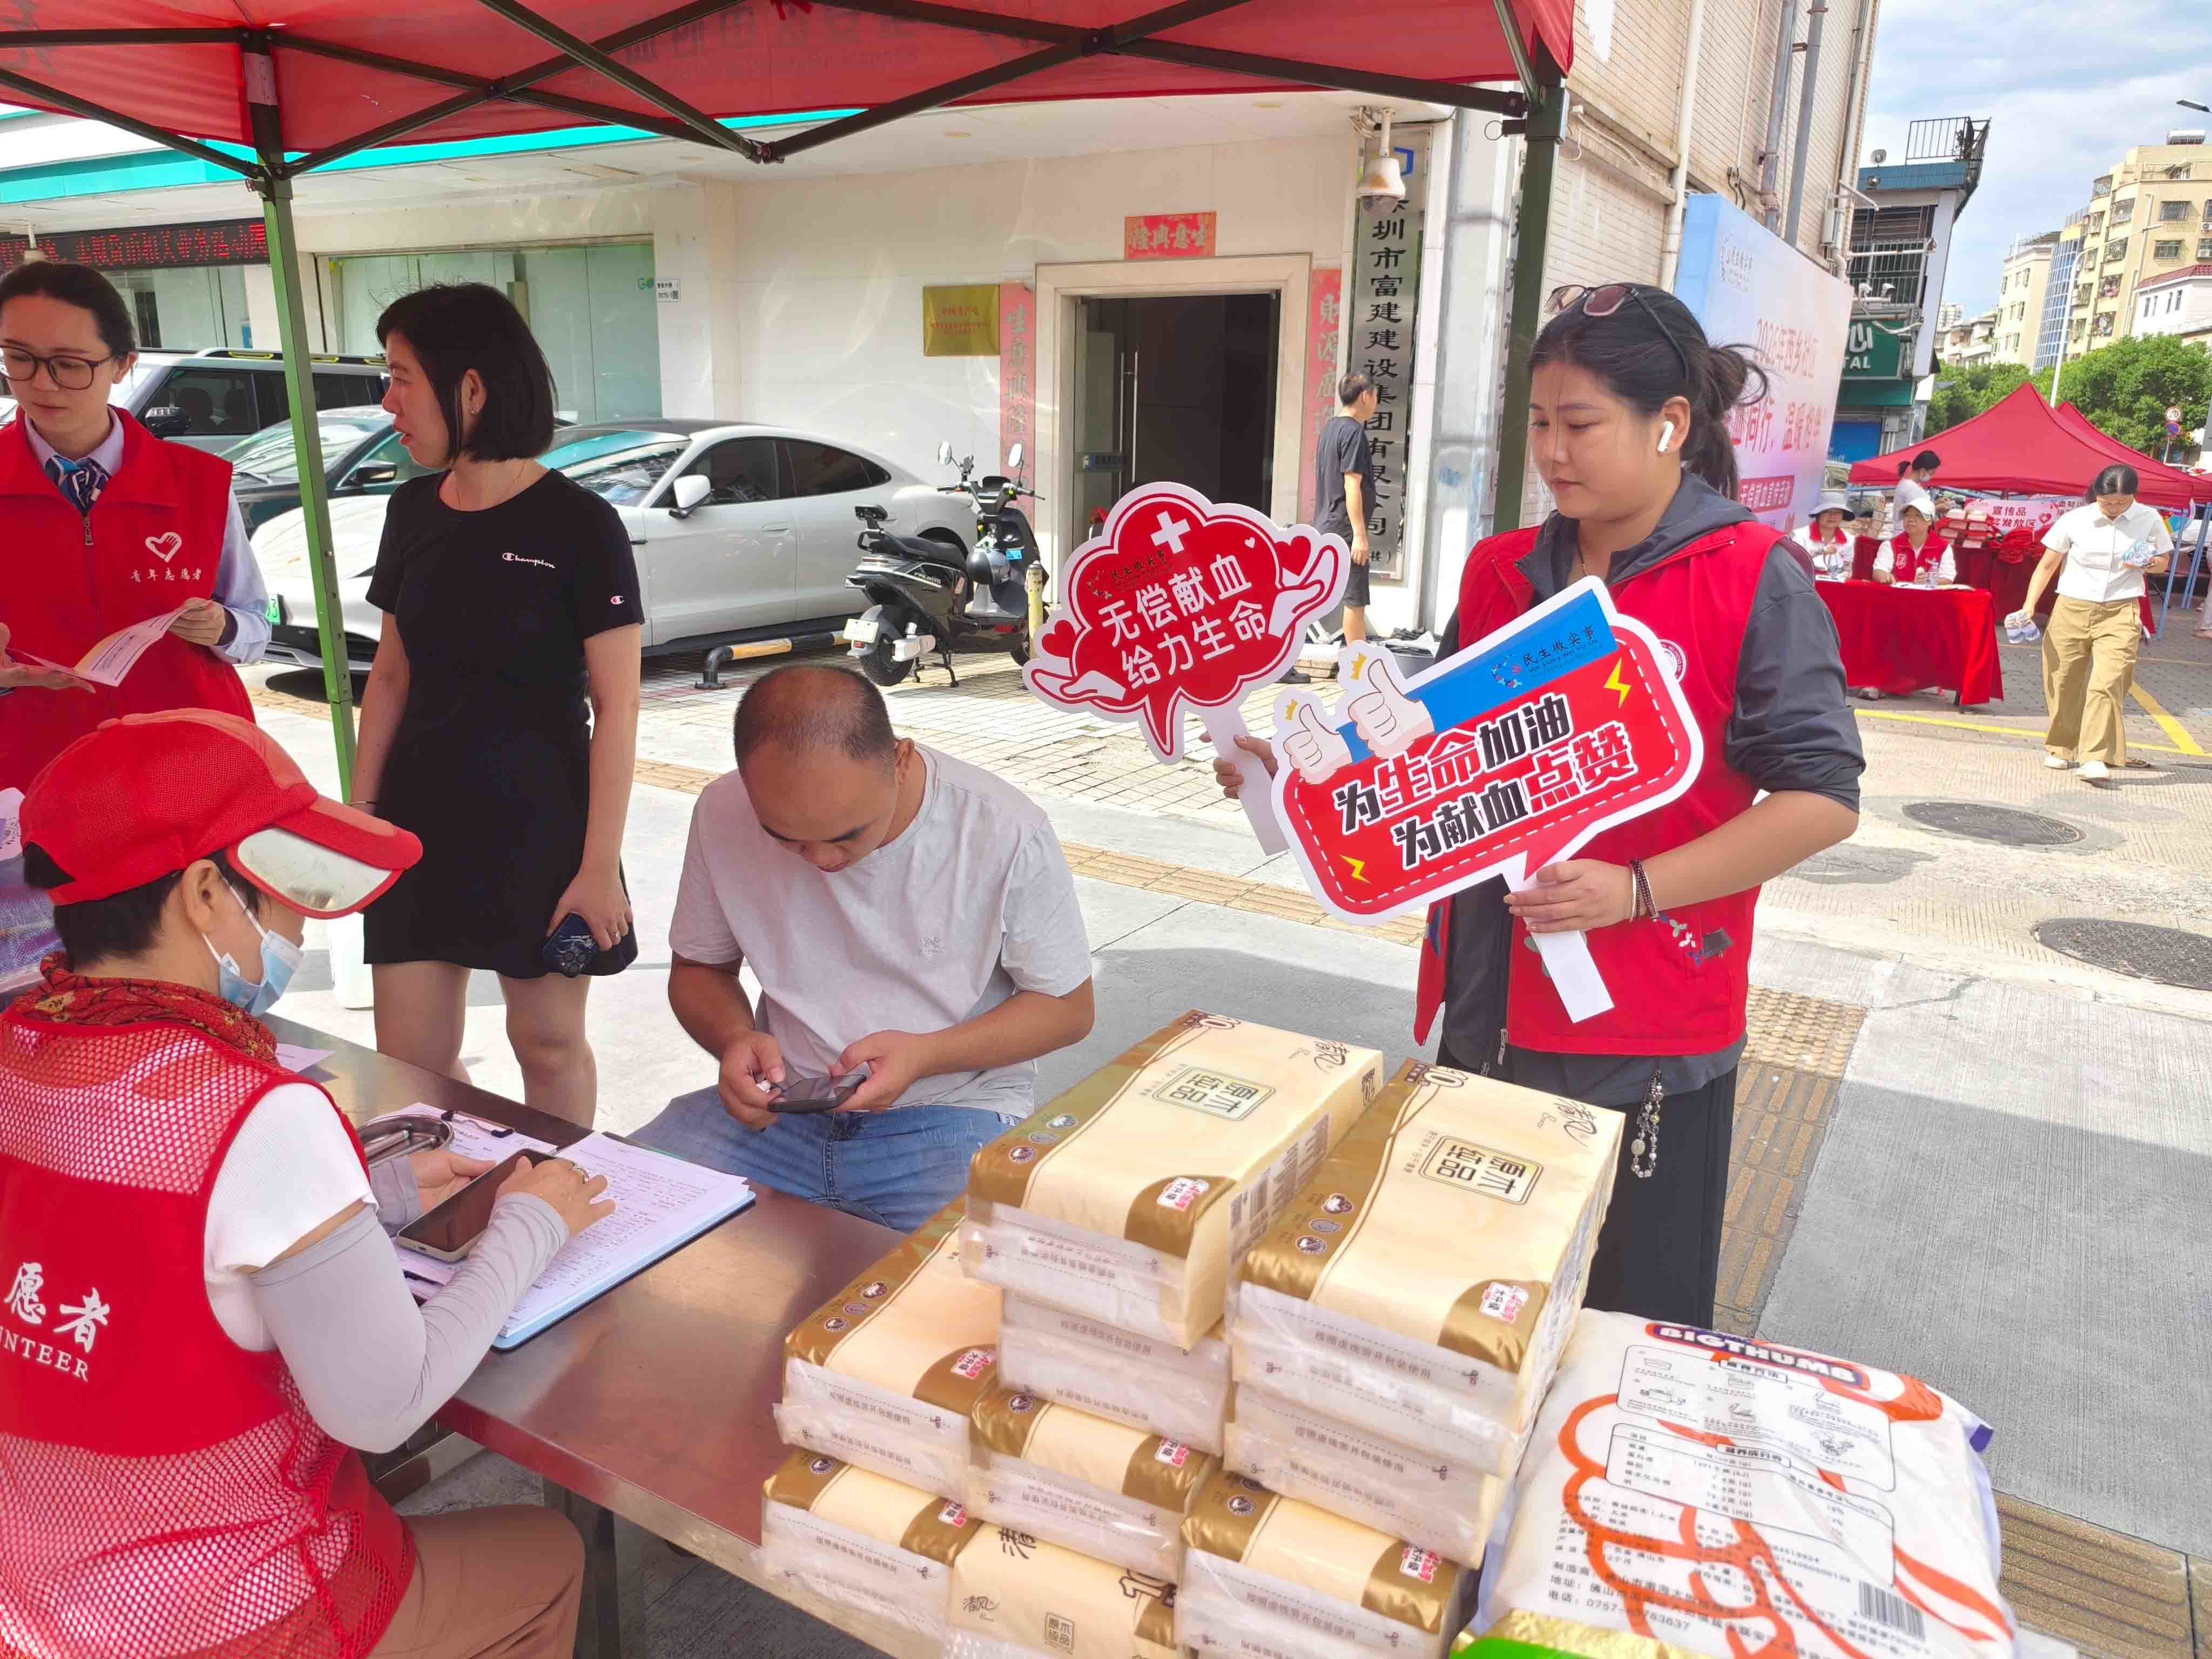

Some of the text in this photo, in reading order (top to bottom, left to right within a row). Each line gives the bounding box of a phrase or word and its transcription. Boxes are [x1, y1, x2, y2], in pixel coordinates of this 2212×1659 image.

[1993, 506, 2026, 517] 宣传品
[130, 567, 202, 583] 青年志愿者
[502, 552, 556, 569] Champion
[1097, 553, 1253, 648] 无偿献血
[1121, 599, 1268, 690] 给力生命
[1522, 625, 1596, 666] 民生微实事
[1334, 693, 1574, 837] 为生命加油
[1393, 721, 1638, 871] 为献血点赞
[1479, 1156, 1528, 1195] 原木
[4, 1262, 110, 1353] 愿者
[1658, 1327, 1858, 1385] BIGTHUMB
